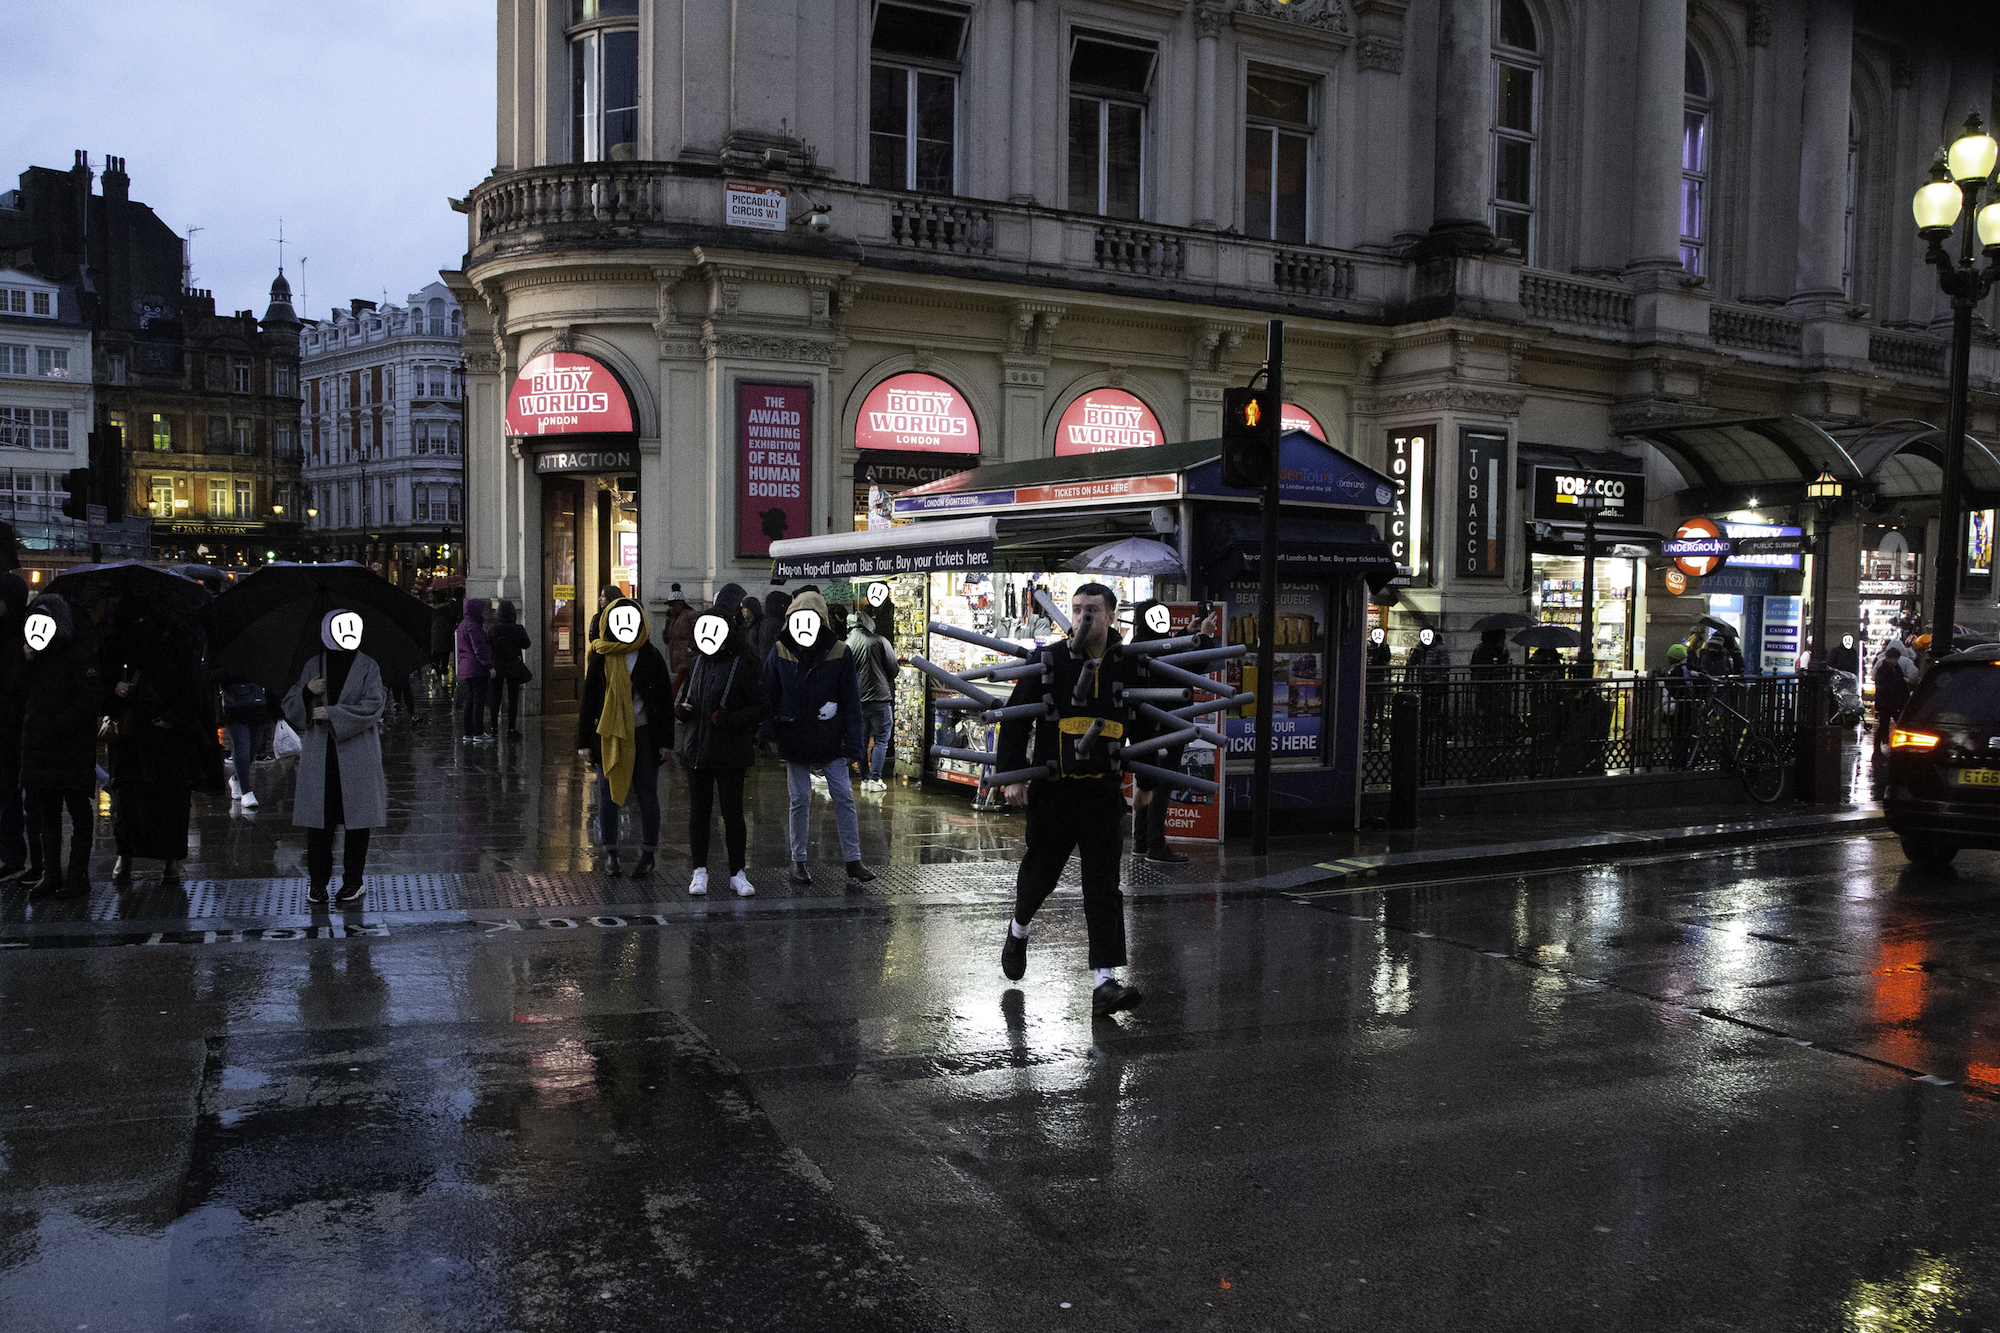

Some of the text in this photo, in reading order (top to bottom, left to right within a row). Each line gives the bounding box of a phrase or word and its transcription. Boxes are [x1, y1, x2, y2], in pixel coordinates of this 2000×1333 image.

[732, 194, 781, 209] PICCADILLY
[732, 205, 778, 219] CIRCUS W1
[531, 372, 593, 394] BODY
[519, 393, 608, 416] WORLDS
[764, 396, 785, 409] THE
[887, 393, 953, 416] BODY
[538, 416, 578, 426] LONDON
[748, 409, 800, 426] AWARD
[869, 412, 967, 436] WORLDS
[1084, 407, 1143, 429] BODY
[748, 426, 800, 439] WINNING
[1068, 425, 1155, 448] WORLDS
[749, 439, 800, 451] EXHIBITION
[896, 435, 940, 446] LONDON
[539, 452, 630, 469] ATTRACTION
[749, 451, 800, 466] OF REAL
[749, 466, 800, 482] HUMAN
[749, 482, 800, 498] BODIES
[1054, 483, 1128, 498] TICKETS ON SALE HERE
[924, 496, 979, 508] LONDON SIGHTSEEING
[1467, 449, 1479, 572] TOBACCO
[171, 525, 247, 535] ST JAMES TAVERN
[1663, 538, 1730, 553] UNDERGROUND
[1753, 541, 1800, 549] PUBLIC SUBWAY
[778, 550, 989, 578] Hop-on Hop-off London Bus Tour, Buy your tickets here.
[1286, 554, 1307, 562] London
[1333, 555, 1344, 563] Buy
[1716, 576, 1769, 588] EXCHANGE
[1236, 593, 1259, 604] BEAT
[1280, 594, 1311, 605] QUEUE
[1172, 617, 1189, 625] THE
[1282, 735, 1317, 750] HERE
[1964, 771, 1999, 783] ET66
[1164, 818, 1196, 829] AGENT
